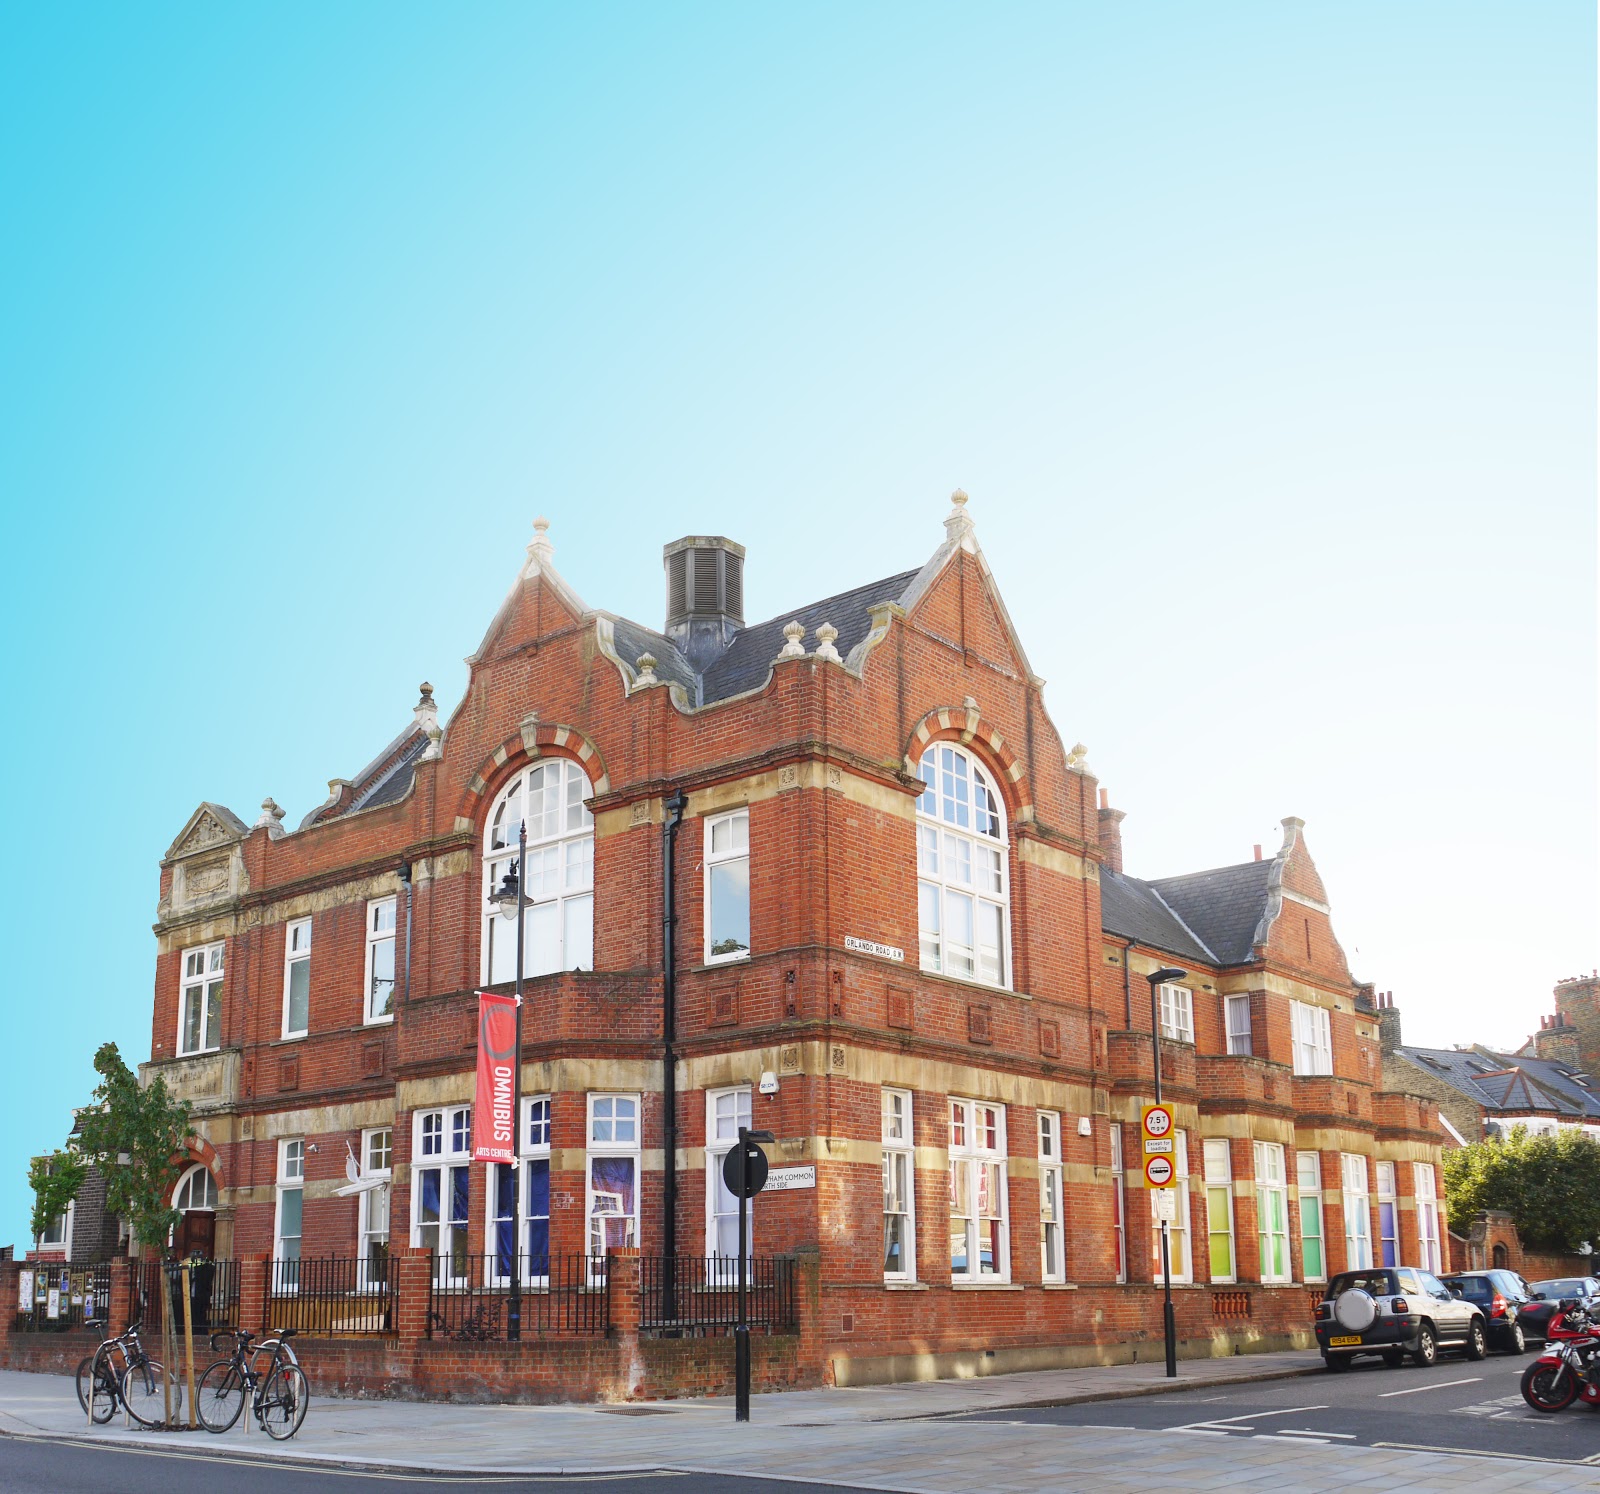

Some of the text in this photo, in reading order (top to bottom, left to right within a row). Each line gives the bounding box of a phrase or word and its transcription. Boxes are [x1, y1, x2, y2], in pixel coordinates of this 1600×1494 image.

[846, 939, 873, 951] ORLANDO
[493, 1066, 512, 1142] OMNIBUS
[476, 1147, 512, 1159] ARTS CENTRE
[784, 1172, 814, 1181] COMMON
[776, 1181, 788, 1189] SIDE
